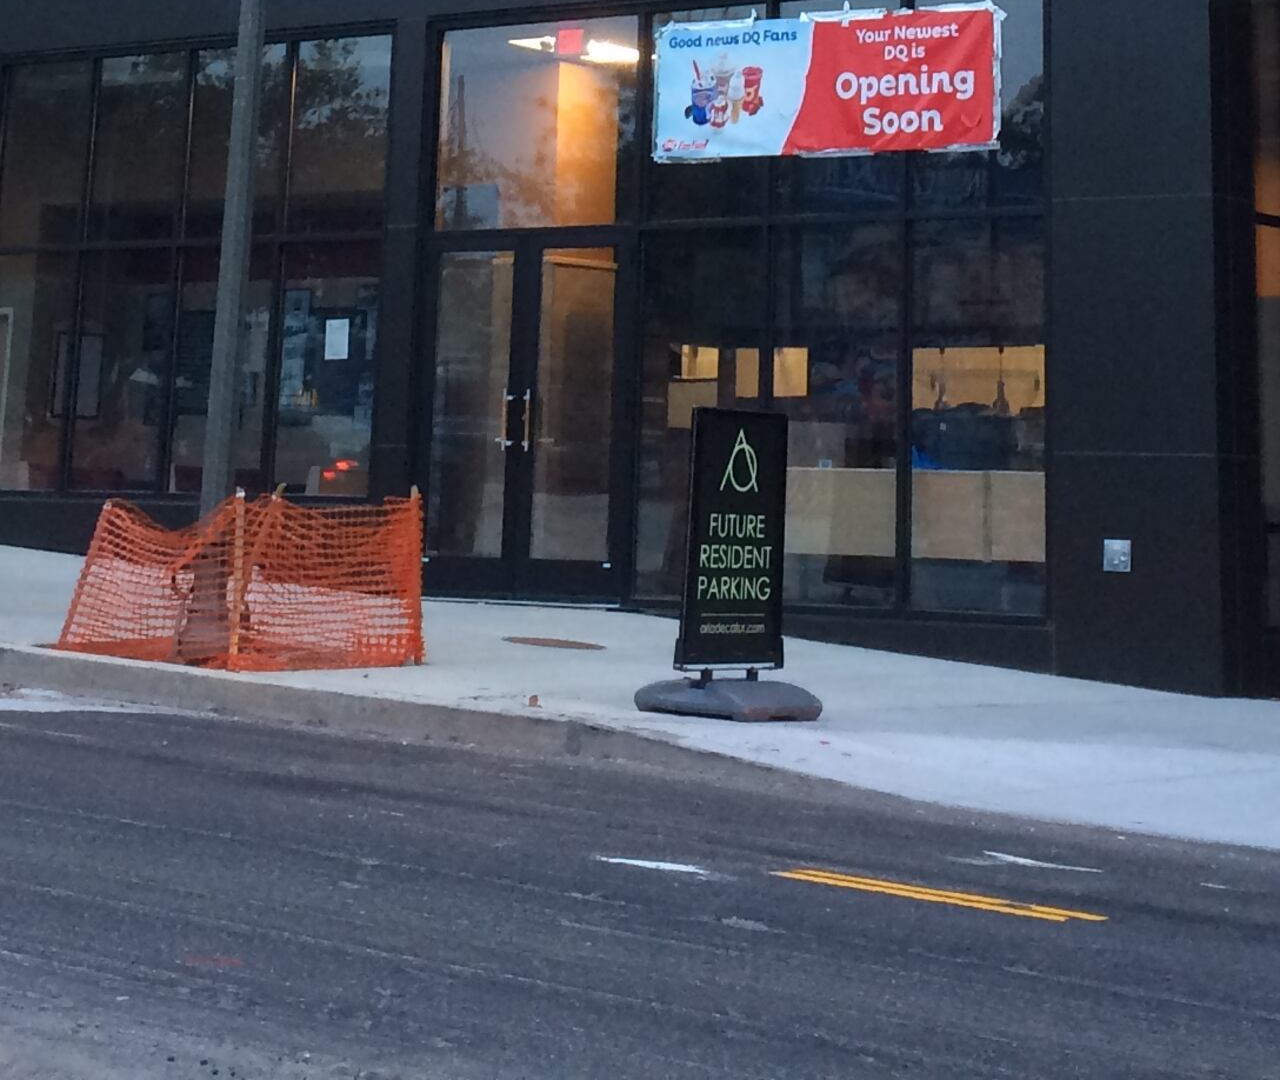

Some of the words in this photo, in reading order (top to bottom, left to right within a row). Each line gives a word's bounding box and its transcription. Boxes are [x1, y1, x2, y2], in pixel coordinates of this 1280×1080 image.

[669, 35, 702, 48] Good
[705, 34, 739, 47] news
[742, 31, 761, 45] DQ
[763, 29, 797, 42] Fans
[856, 28, 891, 44] Your
[893, 22, 959, 41] Newest
[884, 45, 909, 62] DQ
[911, 42, 926, 58] is
[835, 64, 975, 105] Opening
[863, 107, 944, 136] Soon
[709, 513, 765, 538] FUTURE
[699, 544, 772, 569] RESIDENT
[697, 576, 770, 600] PARKING
